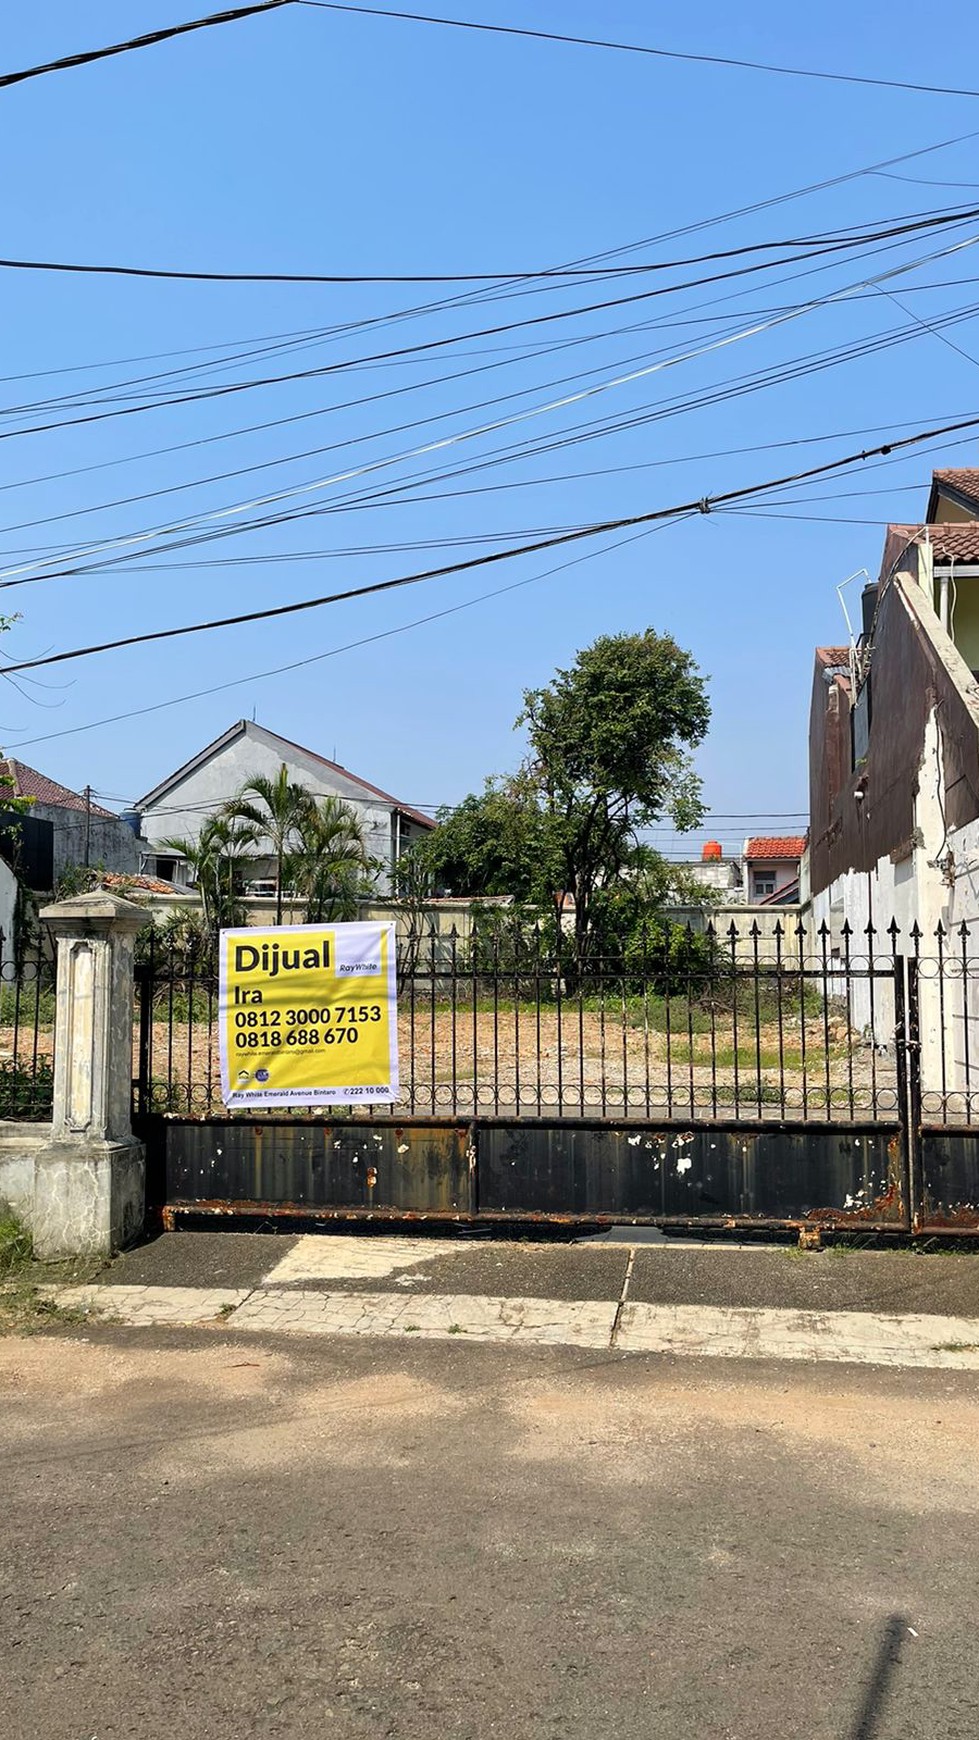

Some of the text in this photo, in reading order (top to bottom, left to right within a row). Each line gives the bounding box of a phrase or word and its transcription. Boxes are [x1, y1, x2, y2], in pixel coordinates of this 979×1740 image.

[235, 940, 330, 976] Dijual
[235, 986, 262, 1004] Ira
[235, 1006, 381, 1028] 0812 3000 7153
[235, 1028, 358, 1048] 0818 688 670
